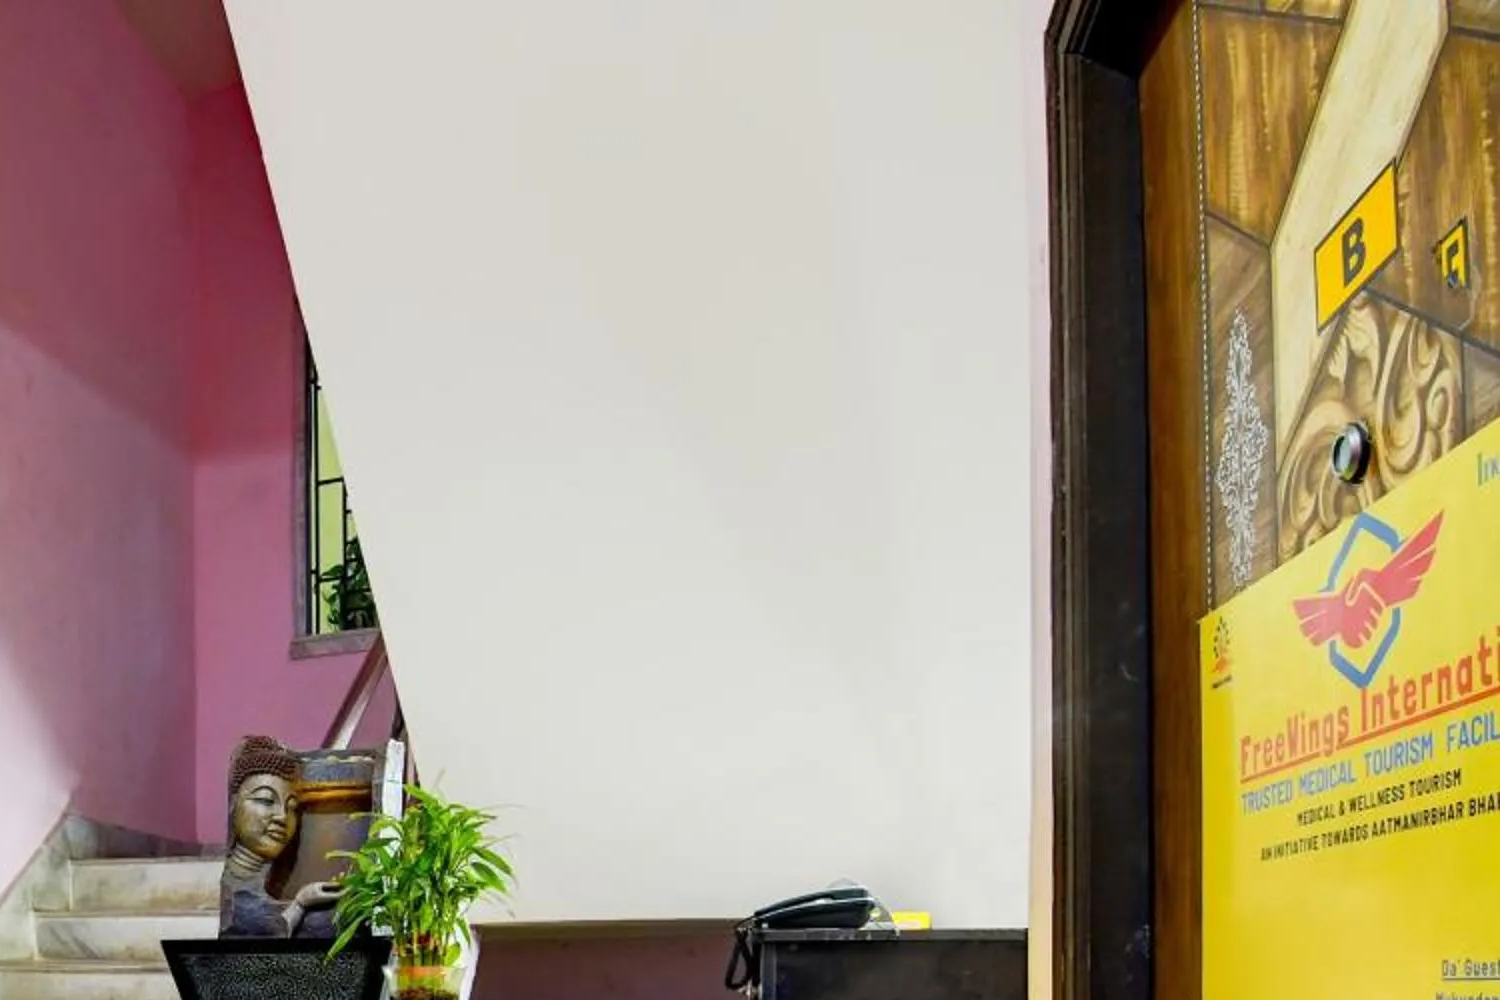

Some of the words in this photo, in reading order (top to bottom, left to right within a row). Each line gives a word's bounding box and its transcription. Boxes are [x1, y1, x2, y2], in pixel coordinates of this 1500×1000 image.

[1341, 217, 1367, 288] B
[1242, 778, 1293, 815] TRUSTED
[1299, 760, 1356, 795] MEDICAL
[1364, 729, 1433, 777] TOURISM
[1297, 803, 1336, 826] MEDICAL
[1338, 800, 1345, 817] &
[1349, 784, 1405, 812] WELLNESS
[1409, 768, 1462, 798] TOURISM
[1321, 823, 1369, 849] TOWARDS
